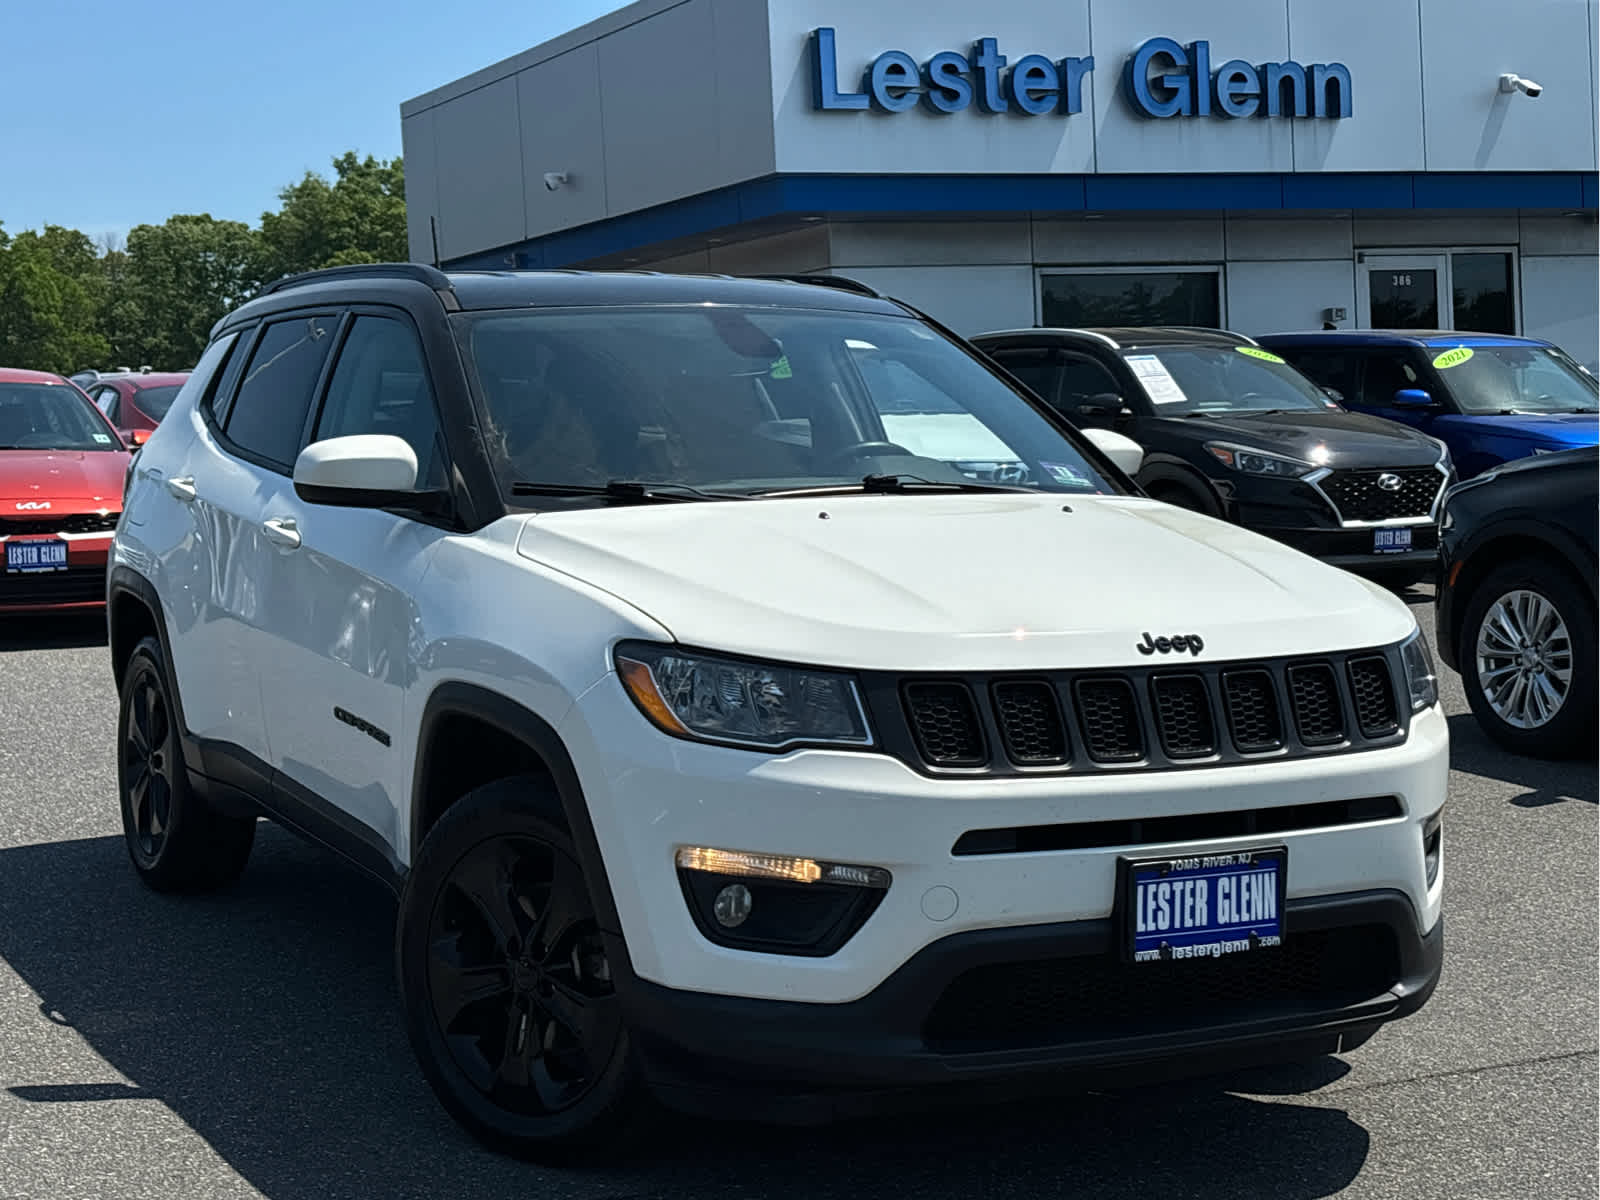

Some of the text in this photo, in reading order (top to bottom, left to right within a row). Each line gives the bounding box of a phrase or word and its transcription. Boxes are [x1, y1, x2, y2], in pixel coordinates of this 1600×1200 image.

[809, 27, 1352, 119] Lester Glenn
[1392, 275, 1411, 286] 386
[1441, 350, 1466, 366] 2021
[8, 544, 66, 564] LESTER GLENN
[1136, 632, 1204, 656] Jeep
[1169, 859, 1200, 871] TOMS
[1238, 853, 1252, 864] NJ
[1136, 872, 1276, 932] LESTER GLENN
